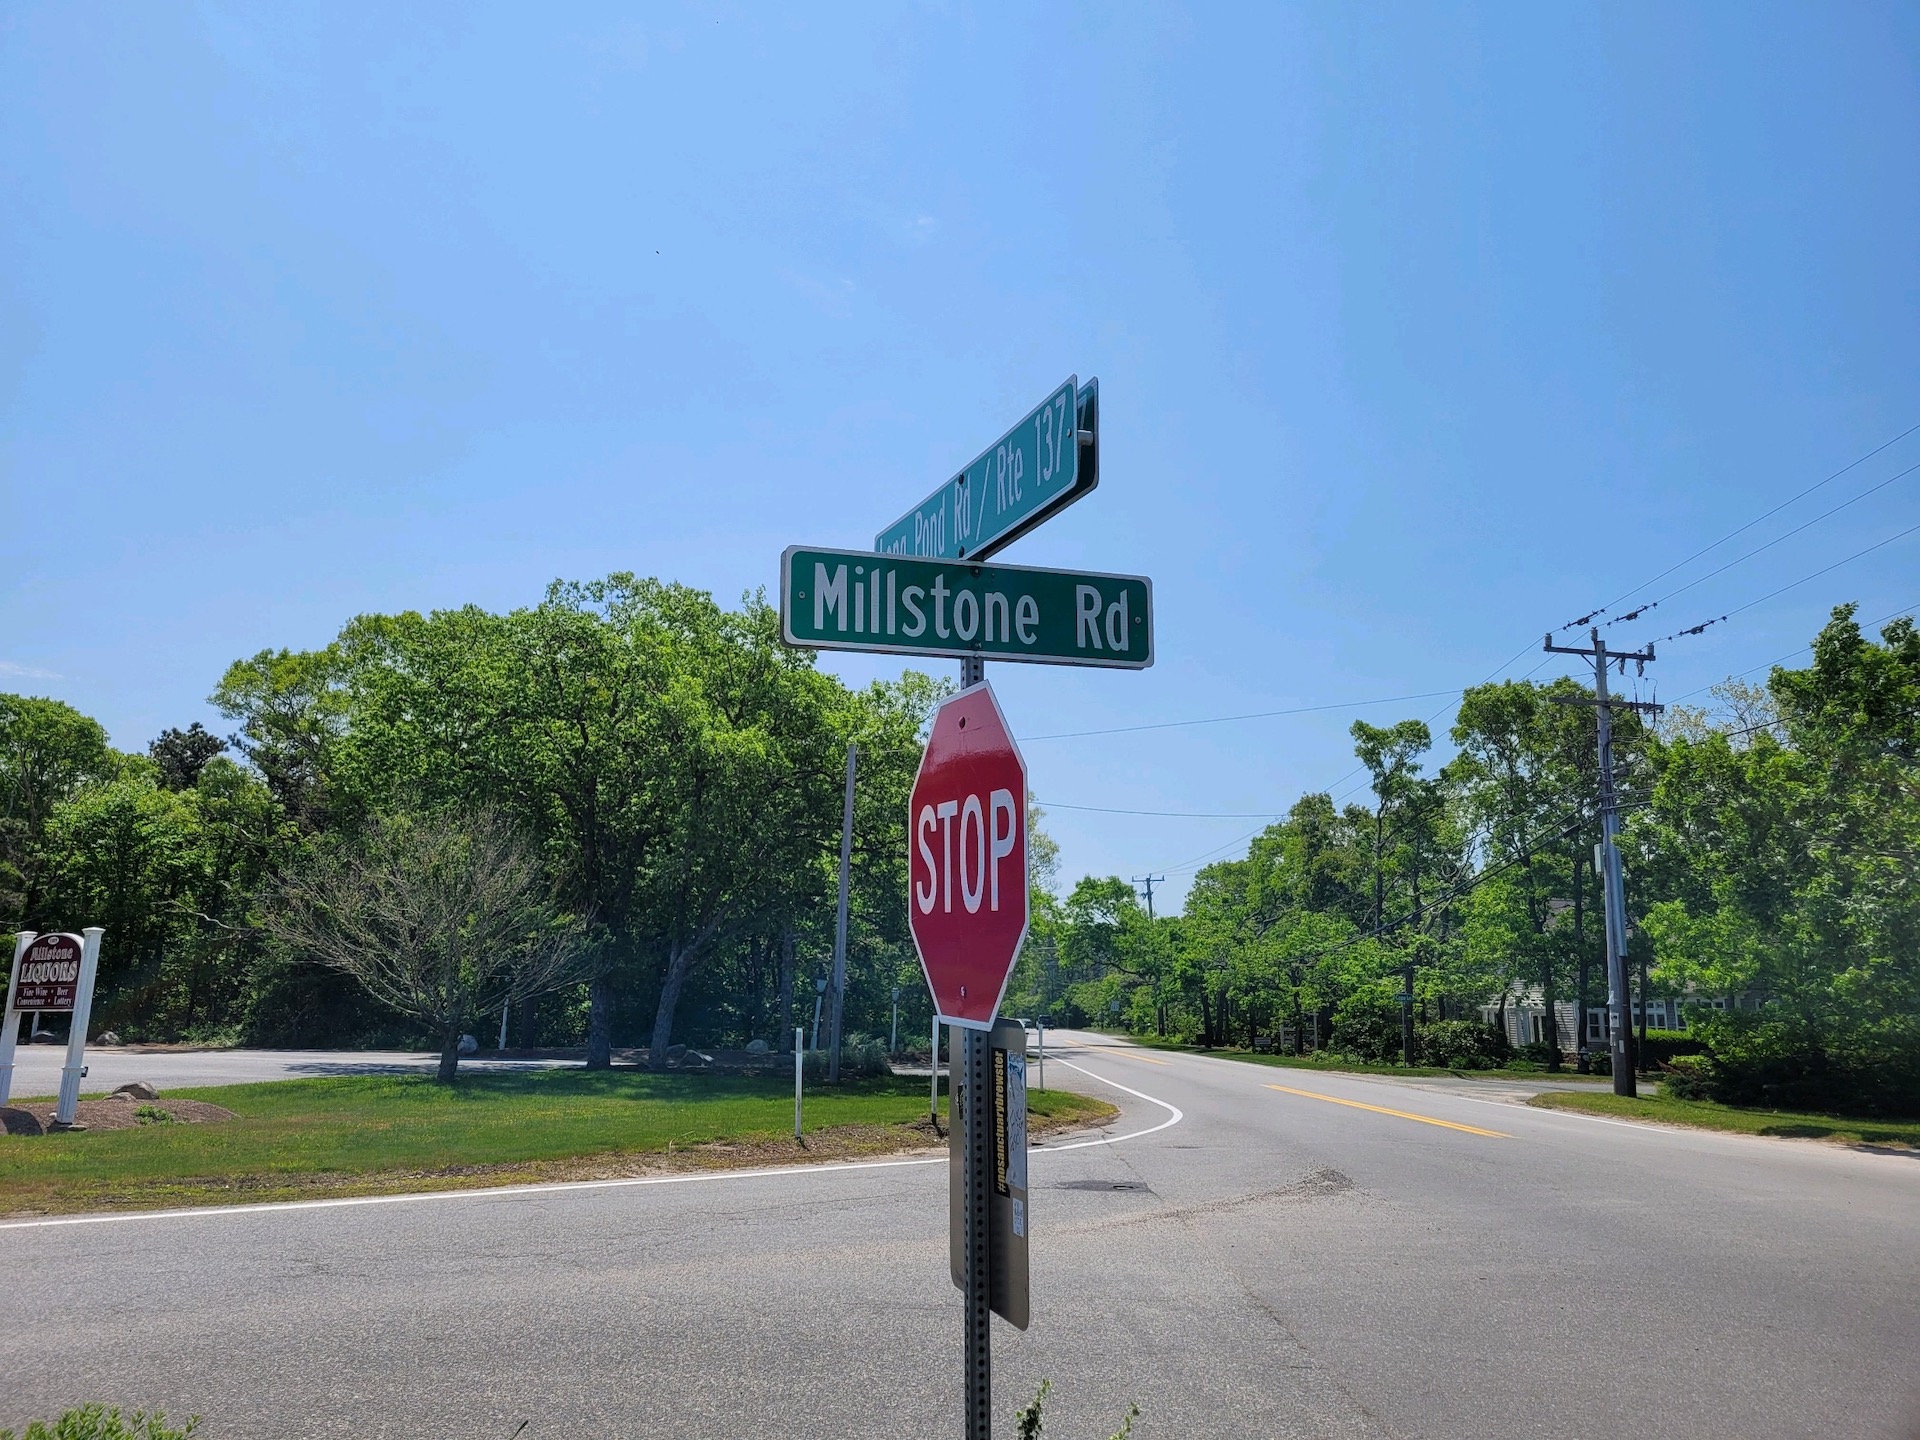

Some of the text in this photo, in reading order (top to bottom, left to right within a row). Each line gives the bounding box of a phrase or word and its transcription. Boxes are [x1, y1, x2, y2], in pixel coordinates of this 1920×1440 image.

[915, 493, 945, 558] Pond
[954, 471, 971, 545] Rd
[975, 457, 991, 541] /
[996, 439, 1024, 515] Rte
[1034, 391, 1067, 488] 137
[813, 562, 1130, 652] Millstone Rd
[916, 788, 1017, 915] STOP
[20, 961, 77, 984] LIQUORS
[23, 987, 69, 997] Fine Wine Beer
[30, 946, 73, 960] Millstone
[995, 1051, 1006, 1192] #nosanctuarybrewster
